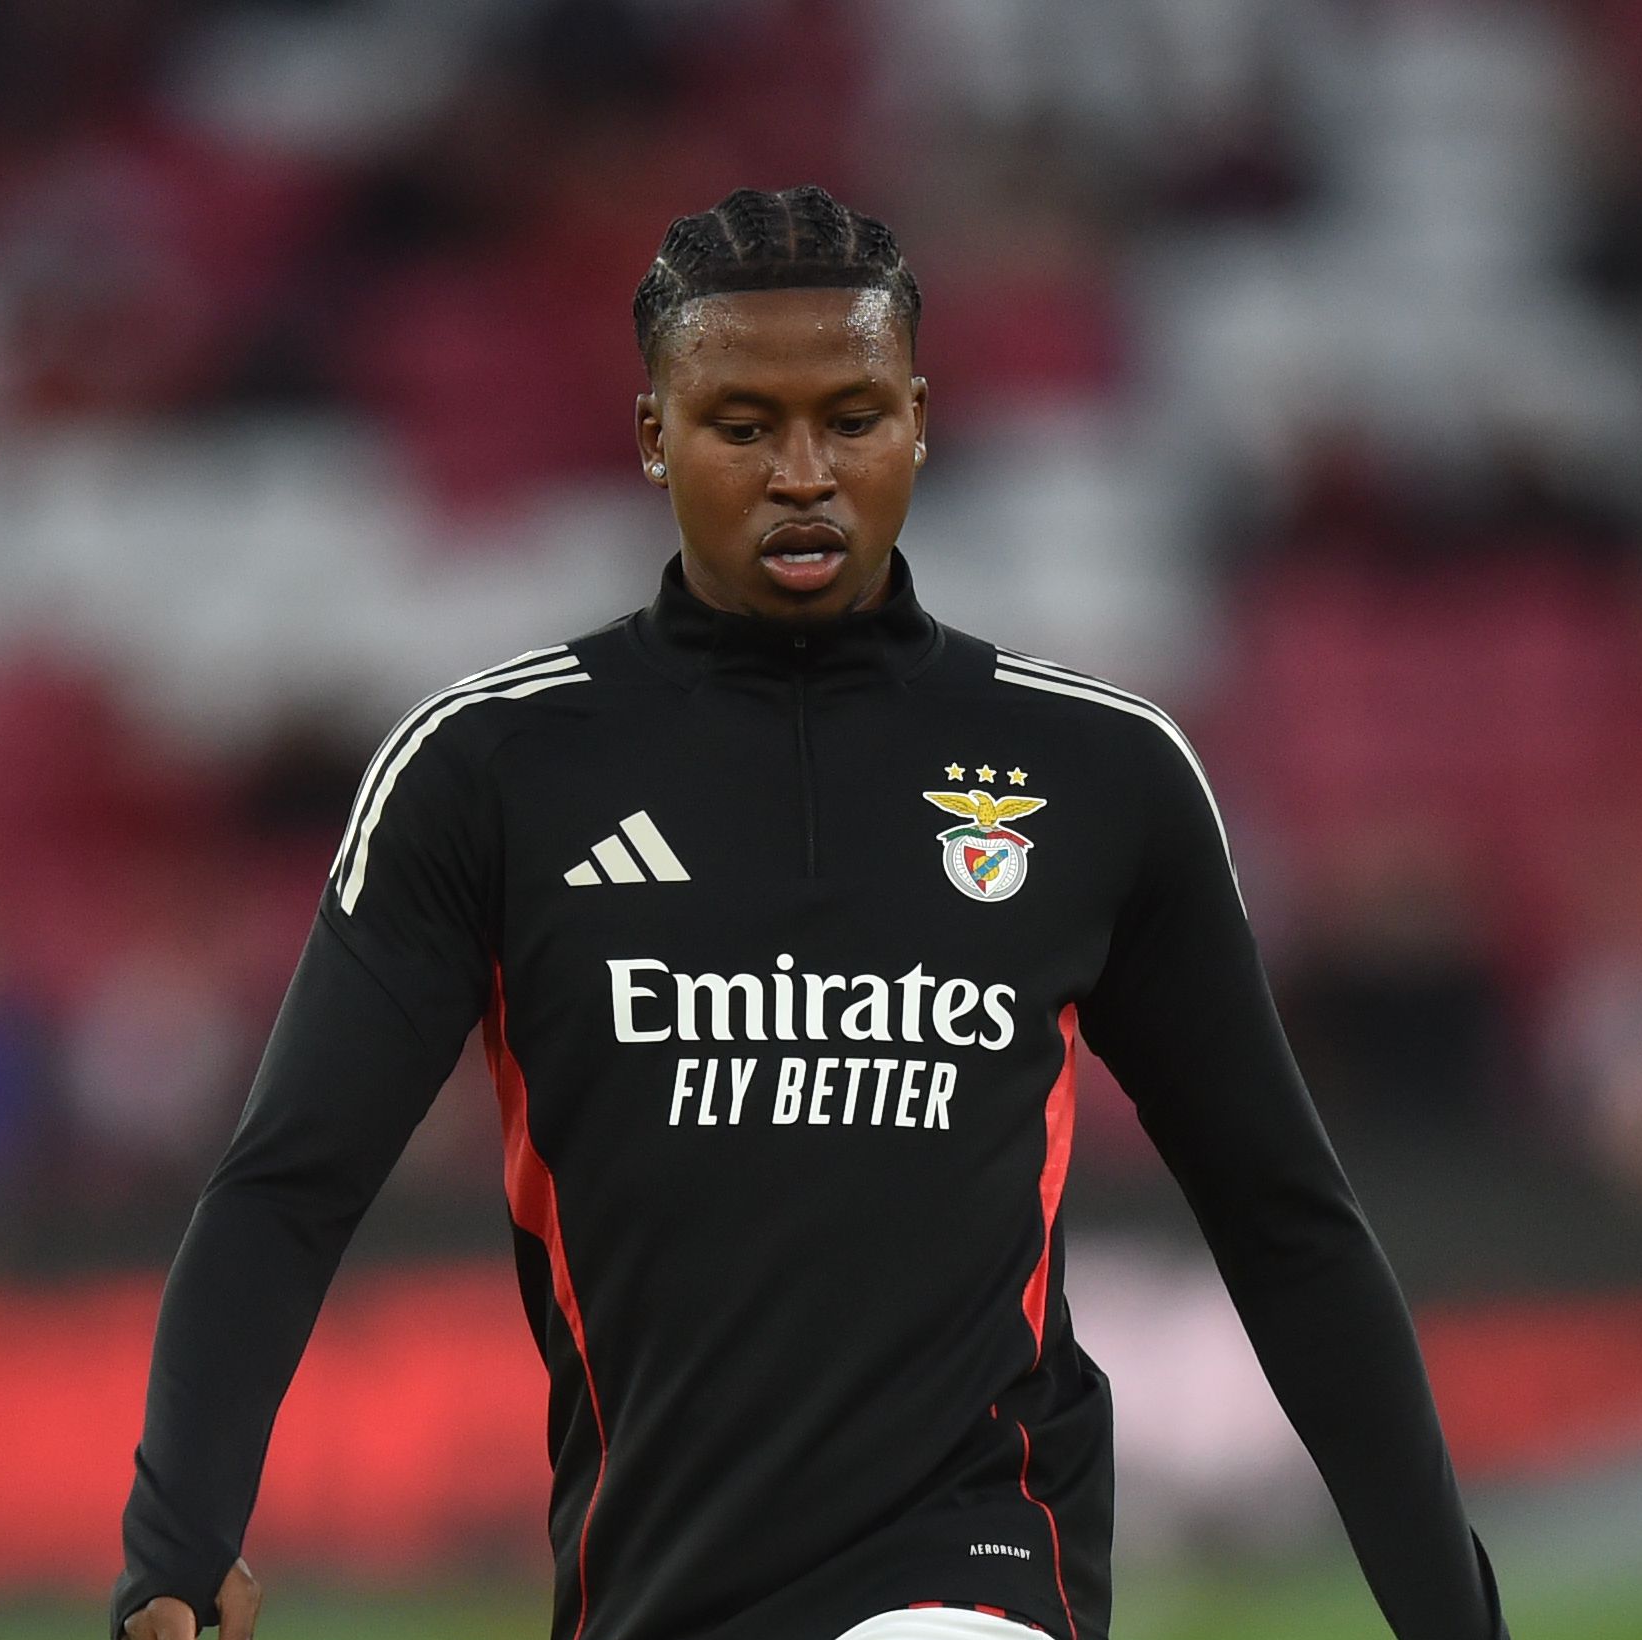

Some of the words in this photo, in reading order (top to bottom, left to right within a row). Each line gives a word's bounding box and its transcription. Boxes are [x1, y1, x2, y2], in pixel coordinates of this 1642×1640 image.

[605, 953, 1016, 1051] Emirates
[668, 1058, 758, 1126] FLY
[772, 1057, 958, 1130] BETTER
[969, 1543, 1031, 1561] AEROREADY
